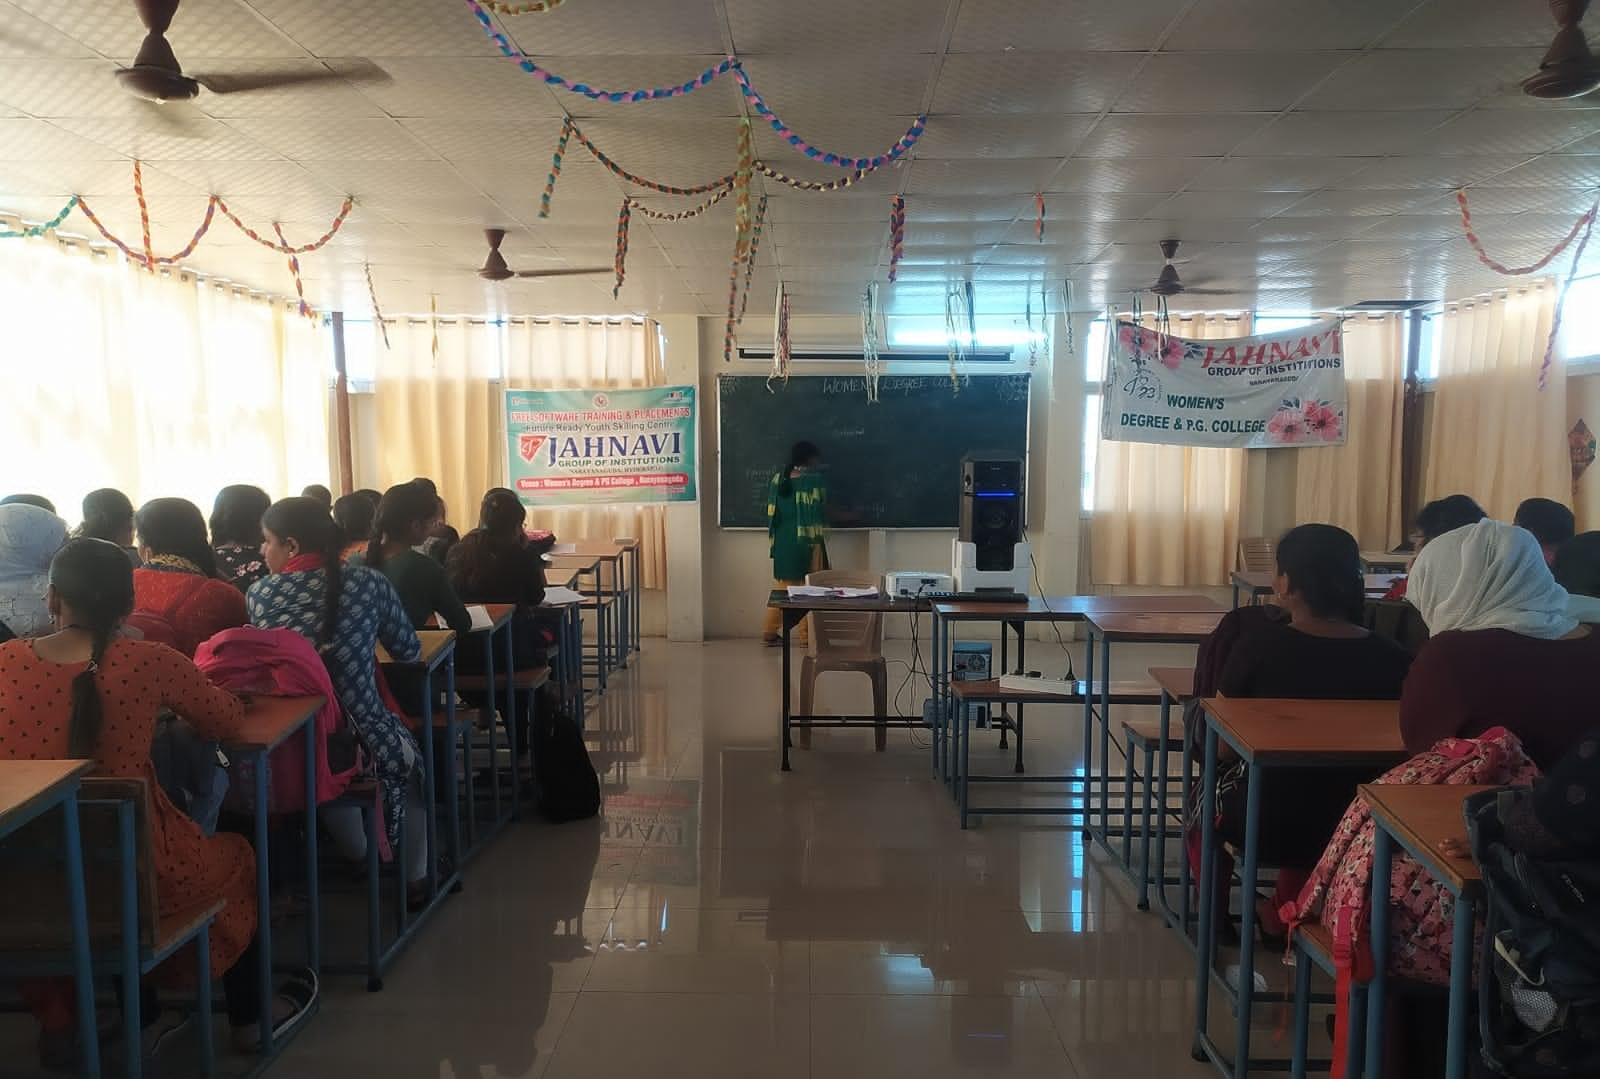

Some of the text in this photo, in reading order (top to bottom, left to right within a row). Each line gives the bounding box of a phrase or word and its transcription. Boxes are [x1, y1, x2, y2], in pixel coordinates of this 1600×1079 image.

[1201, 329, 1341, 368] JAHNAVI
[1207, 366, 1247, 376] GROUP
[1249, 366, 1262, 376] OF
[1167, 394, 1225, 410] WOMEN'S
[583, 409, 622, 421] TRAINING
[634, 407, 690, 419] PLACEMENTS
[556, 423, 582, 433] Ready
[585, 422, 610, 431] Youth
[613, 421, 645, 432] Skilling
[1121, 412, 1265, 433] DEGREE & P.G. COLLEGE
[548, 432, 681, 467] JAHNAVI
[558, 456, 680, 468] GROUP OF INSTITUTIONS
